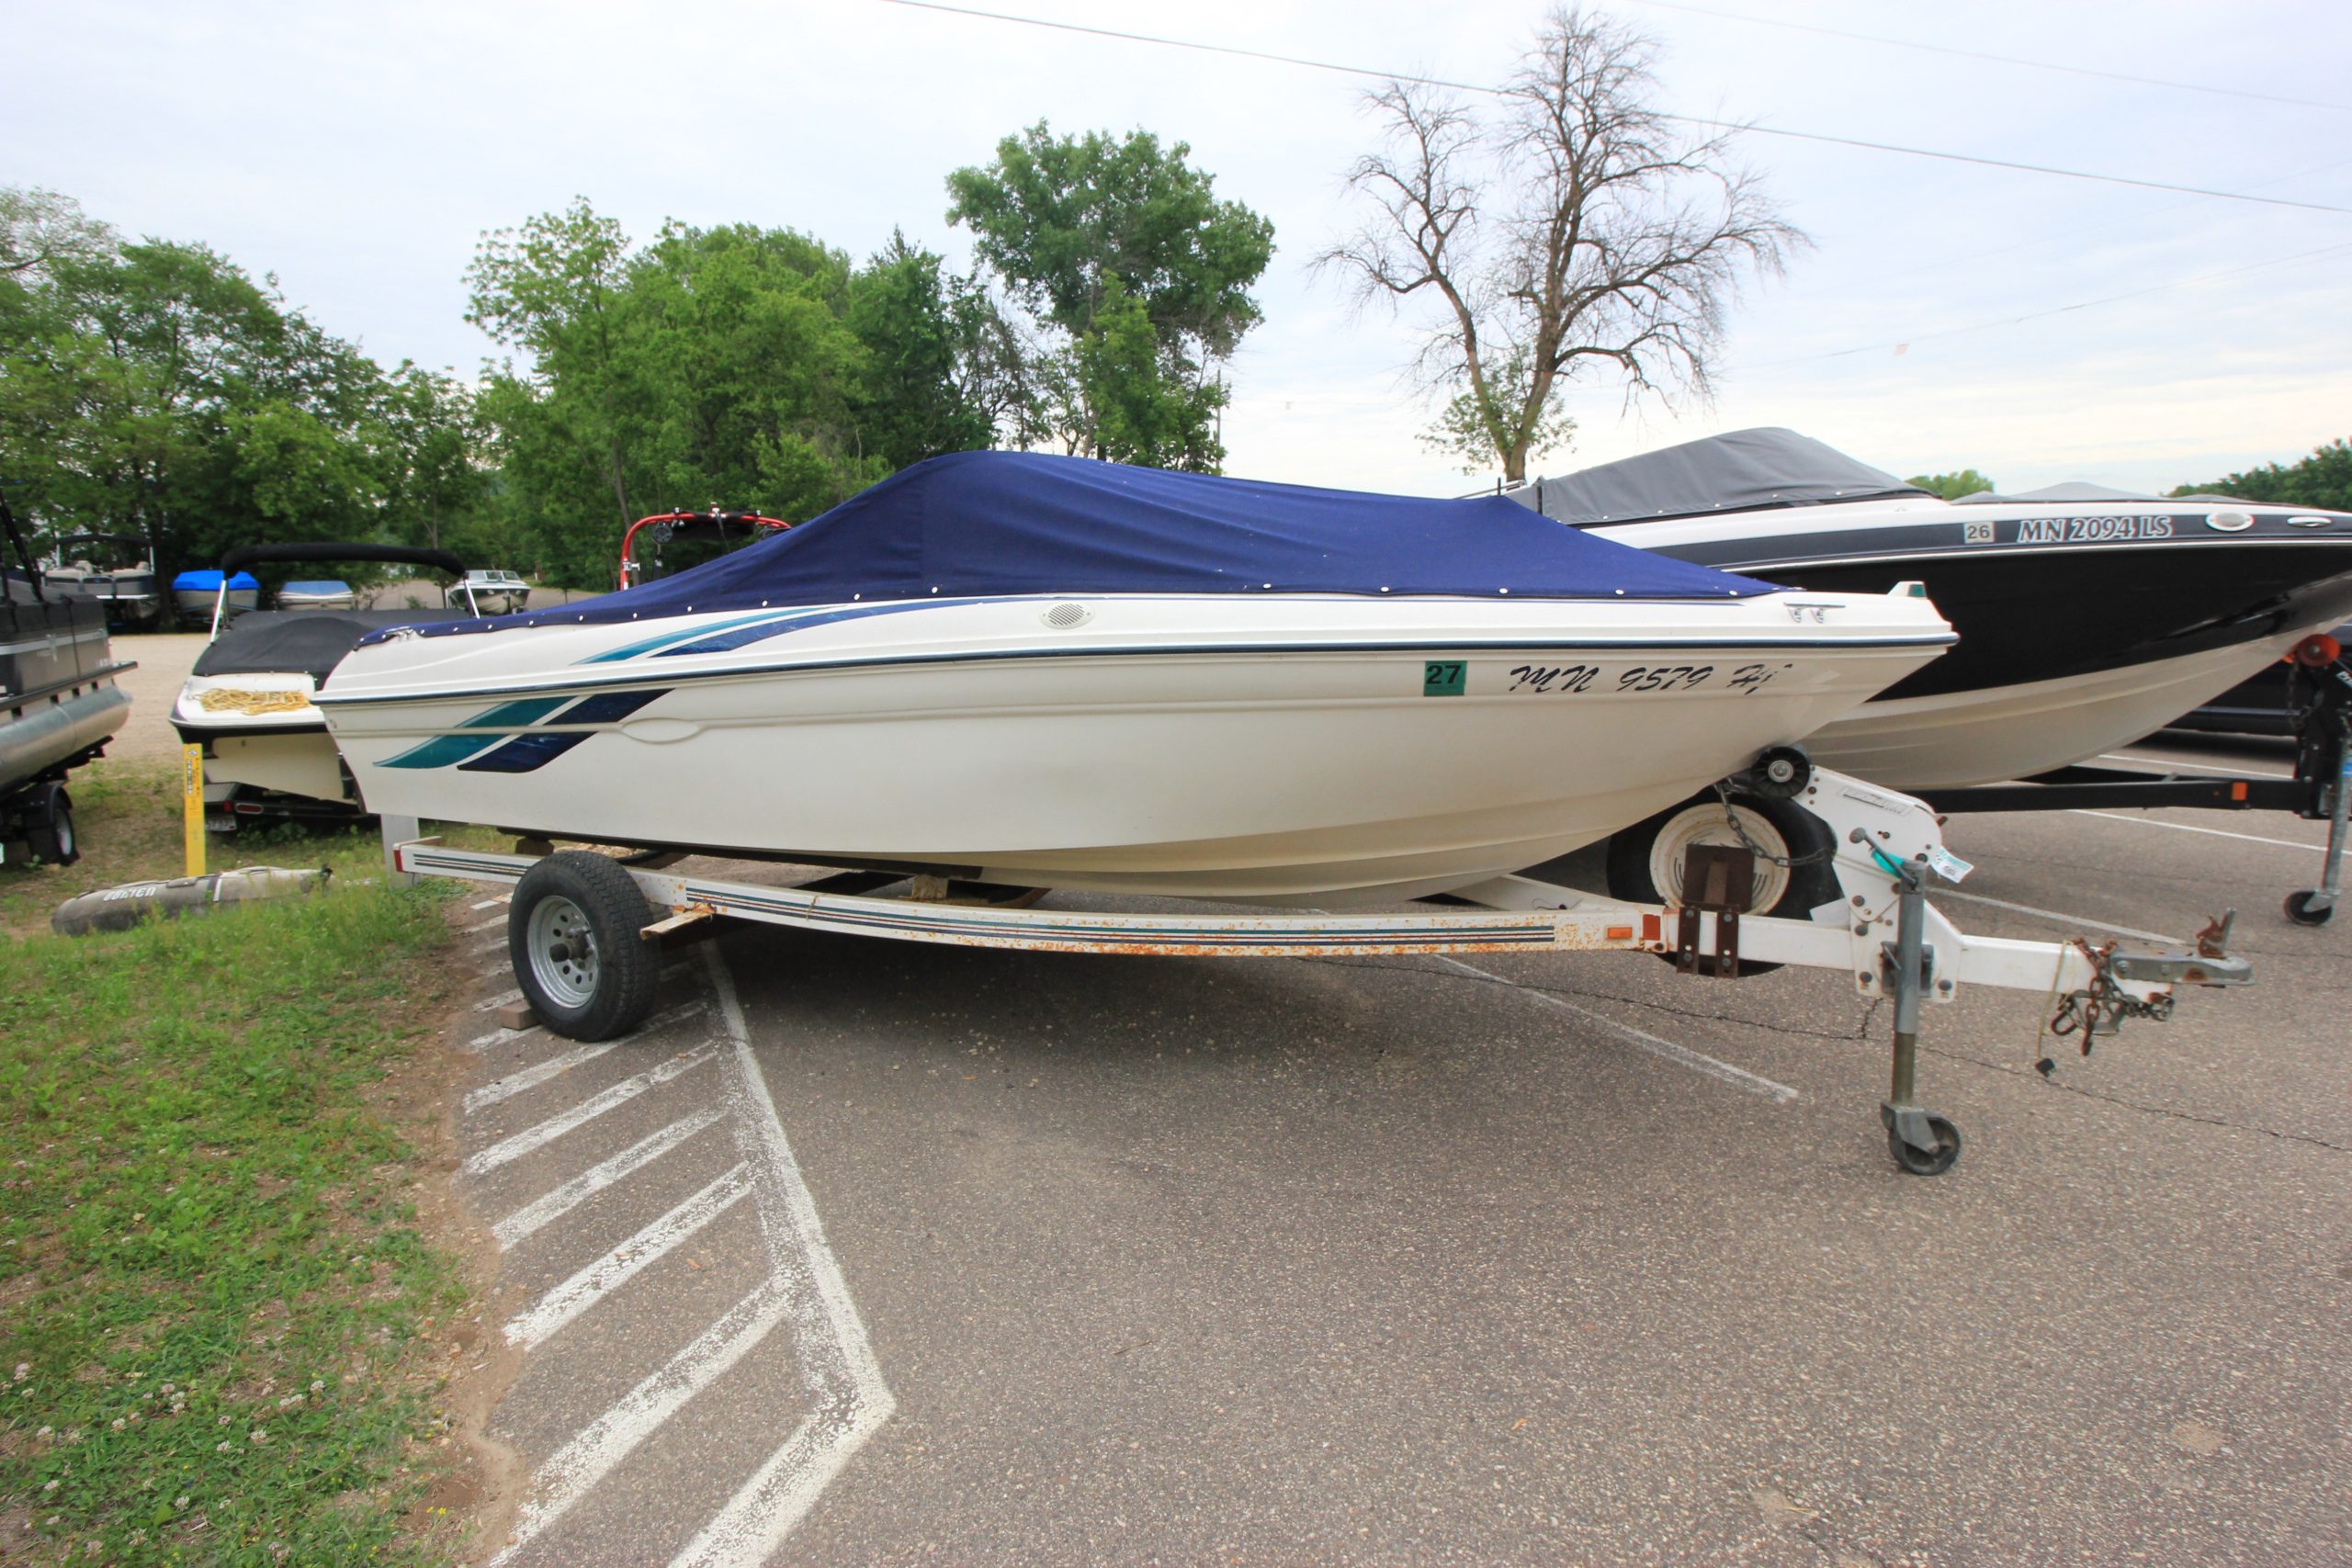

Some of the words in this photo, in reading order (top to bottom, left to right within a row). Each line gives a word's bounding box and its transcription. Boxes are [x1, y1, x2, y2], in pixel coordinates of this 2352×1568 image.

[1965, 525, 1991, 540] 26
[2017, 519, 2066, 544] MN
[2068, 516, 2137, 541] 2094
[2139, 514, 2174, 539] LS
[1426, 664, 1463, 684] 27
[1510, 664, 1600, 694] MN
[1615, 665, 1714, 692] 9579
